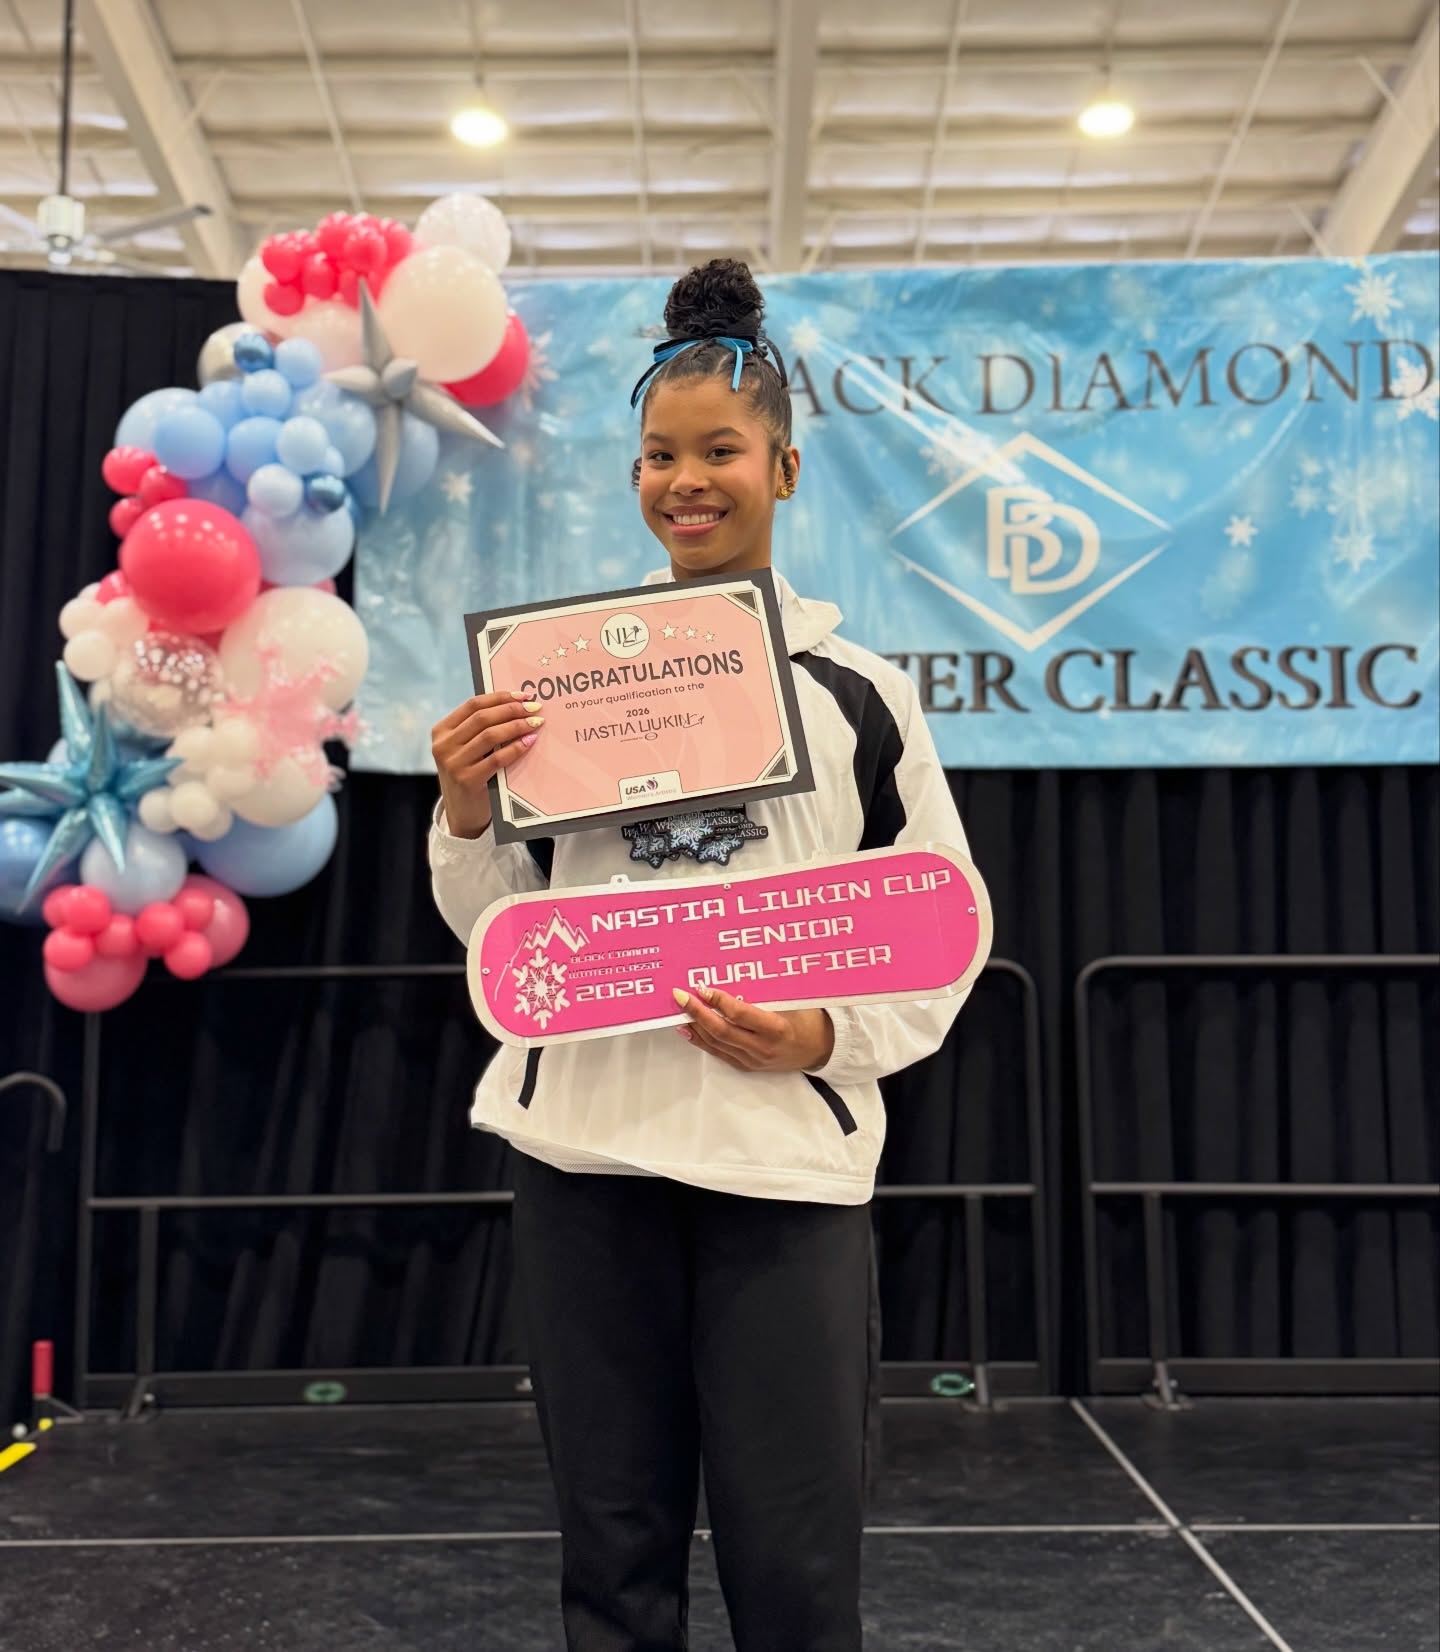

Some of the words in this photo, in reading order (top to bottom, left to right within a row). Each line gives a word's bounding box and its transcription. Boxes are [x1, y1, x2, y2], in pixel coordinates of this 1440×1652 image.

[788, 356, 957, 416] ACK
[976, 338, 1435, 416] DIAMOND
[986, 486, 1101, 594] BD
[520, 649, 744, 703] CONGRATULATIONS
[1044, 643, 1422, 714] CLASSIC
[565, 701, 579, 710] on
[580, 696, 604, 709] your
[605, 686, 673, 705] qualification
[674, 685, 686, 694] to
[687, 681, 705, 691] the
[625, 707, 651, 718] 2026
[575, 722, 637, 743] NASTIA
[638, 712, 692, 733] LIUKIN
[625, 785, 647, 795] USA
[591, 898, 726, 933] NASTIA
[736, 878, 872, 915] LIUKIN
[882, 867, 951, 897] CUP
[717, 914, 855, 951] SENIOR
[570, 951, 605, 964] BLACK
[615, 960, 664, 974] CLASSIC
[687, 943, 893, 988] QUALIFIER
[575, 976, 655, 1002] 2026
